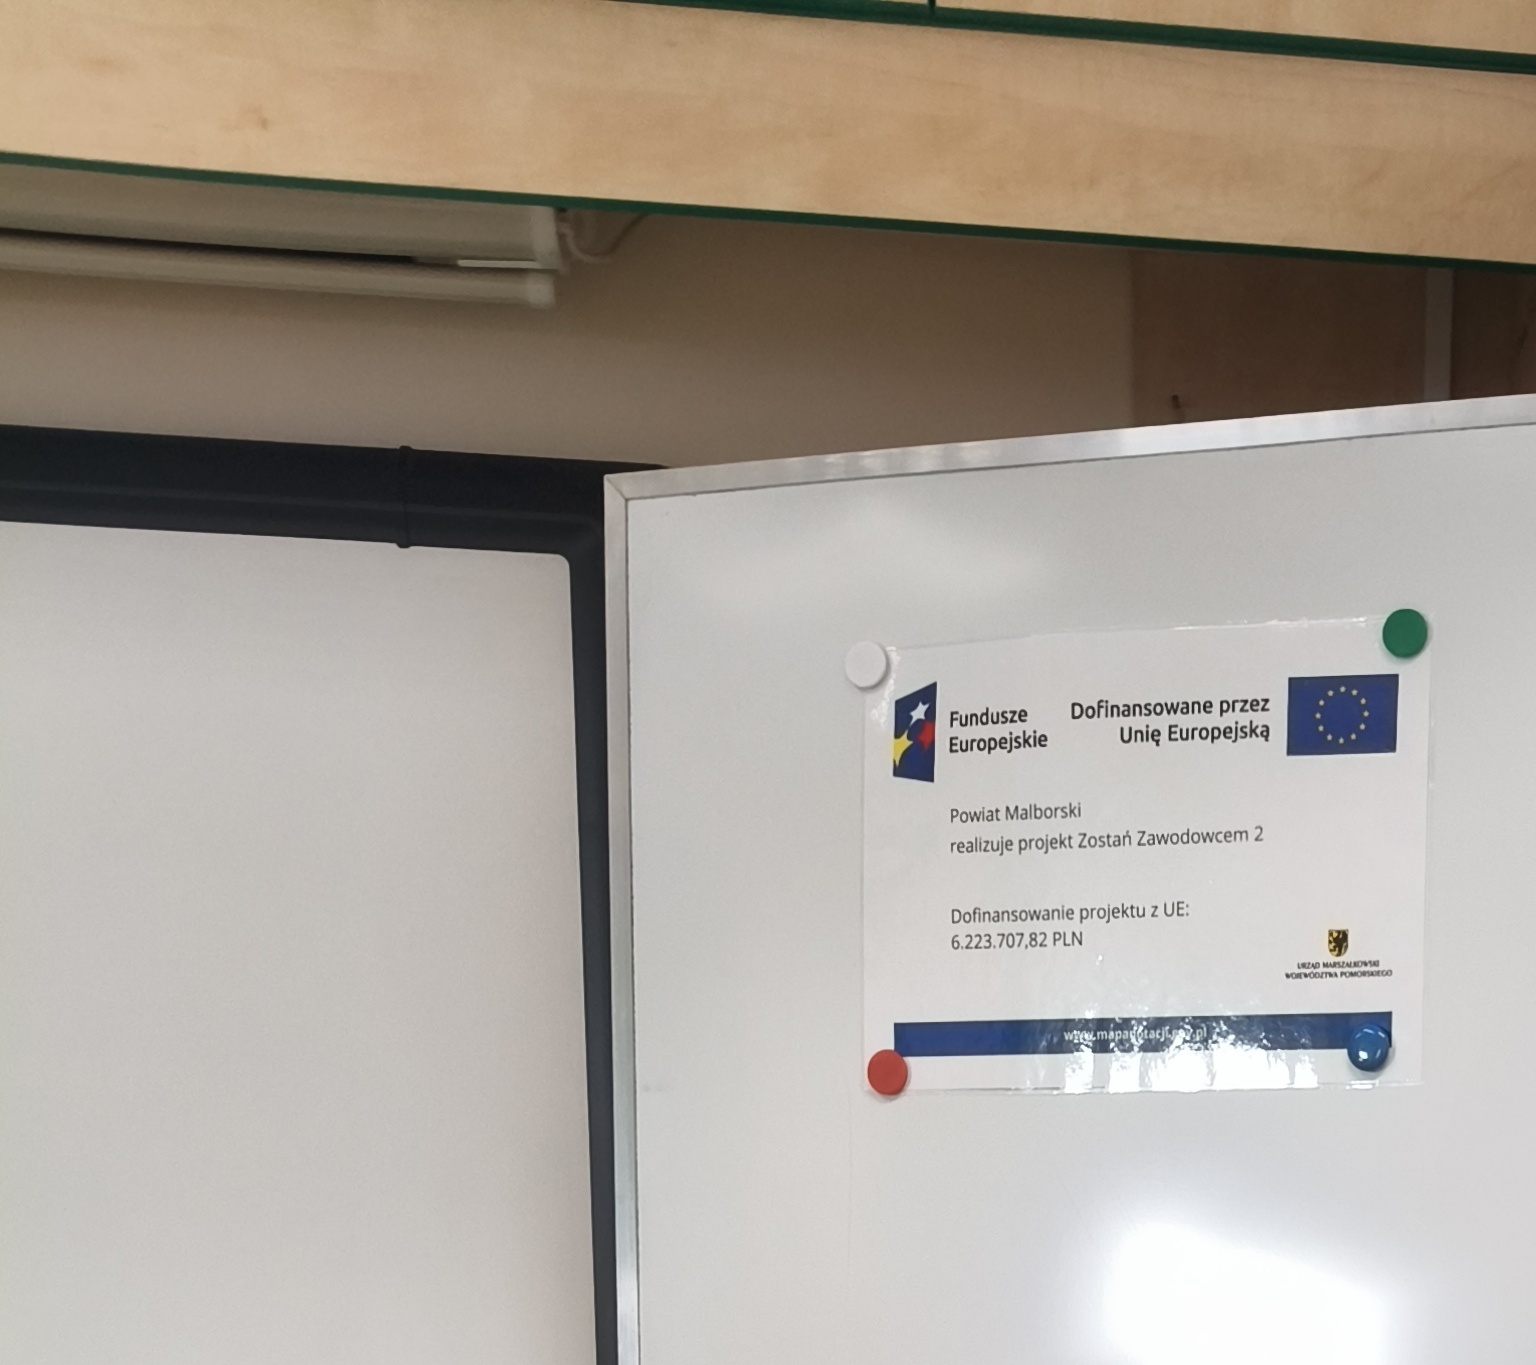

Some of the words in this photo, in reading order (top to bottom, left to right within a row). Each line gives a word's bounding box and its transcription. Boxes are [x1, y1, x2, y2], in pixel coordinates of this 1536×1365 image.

[949, 706, 1029, 728] Fundusze
[1070, 698, 1214, 720] Dofinansowane
[1219, 697, 1271, 718] przez
[948, 730, 1049, 755] Europejskie
[1119, 723, 1162, 748] Unię
[1167, 719, 1271, 745] Europejską
[950, 806, 1001, 824] Powiat
[1005, 802, 1082, 821] Malborski
[950, 835, 1014, 857] realizuje
[1018, 832, 1074, 854] projekt
[1077, 829, 1132, 849] Zostań
[1136, 827, 1249, 847] Zawodowcem
[1254, 825, 1264, 842] 2
[951, 904, 1075, 925] Dofinansowanie
[1079, 902, 1146, 925] projektu
[1150, 904, 1159, 918] z
[1163, 900, 1190, 919] UE:
[950, 931, 1048, 951] 6.223.707,82
[1052, 930, 1083, 947] PLN
